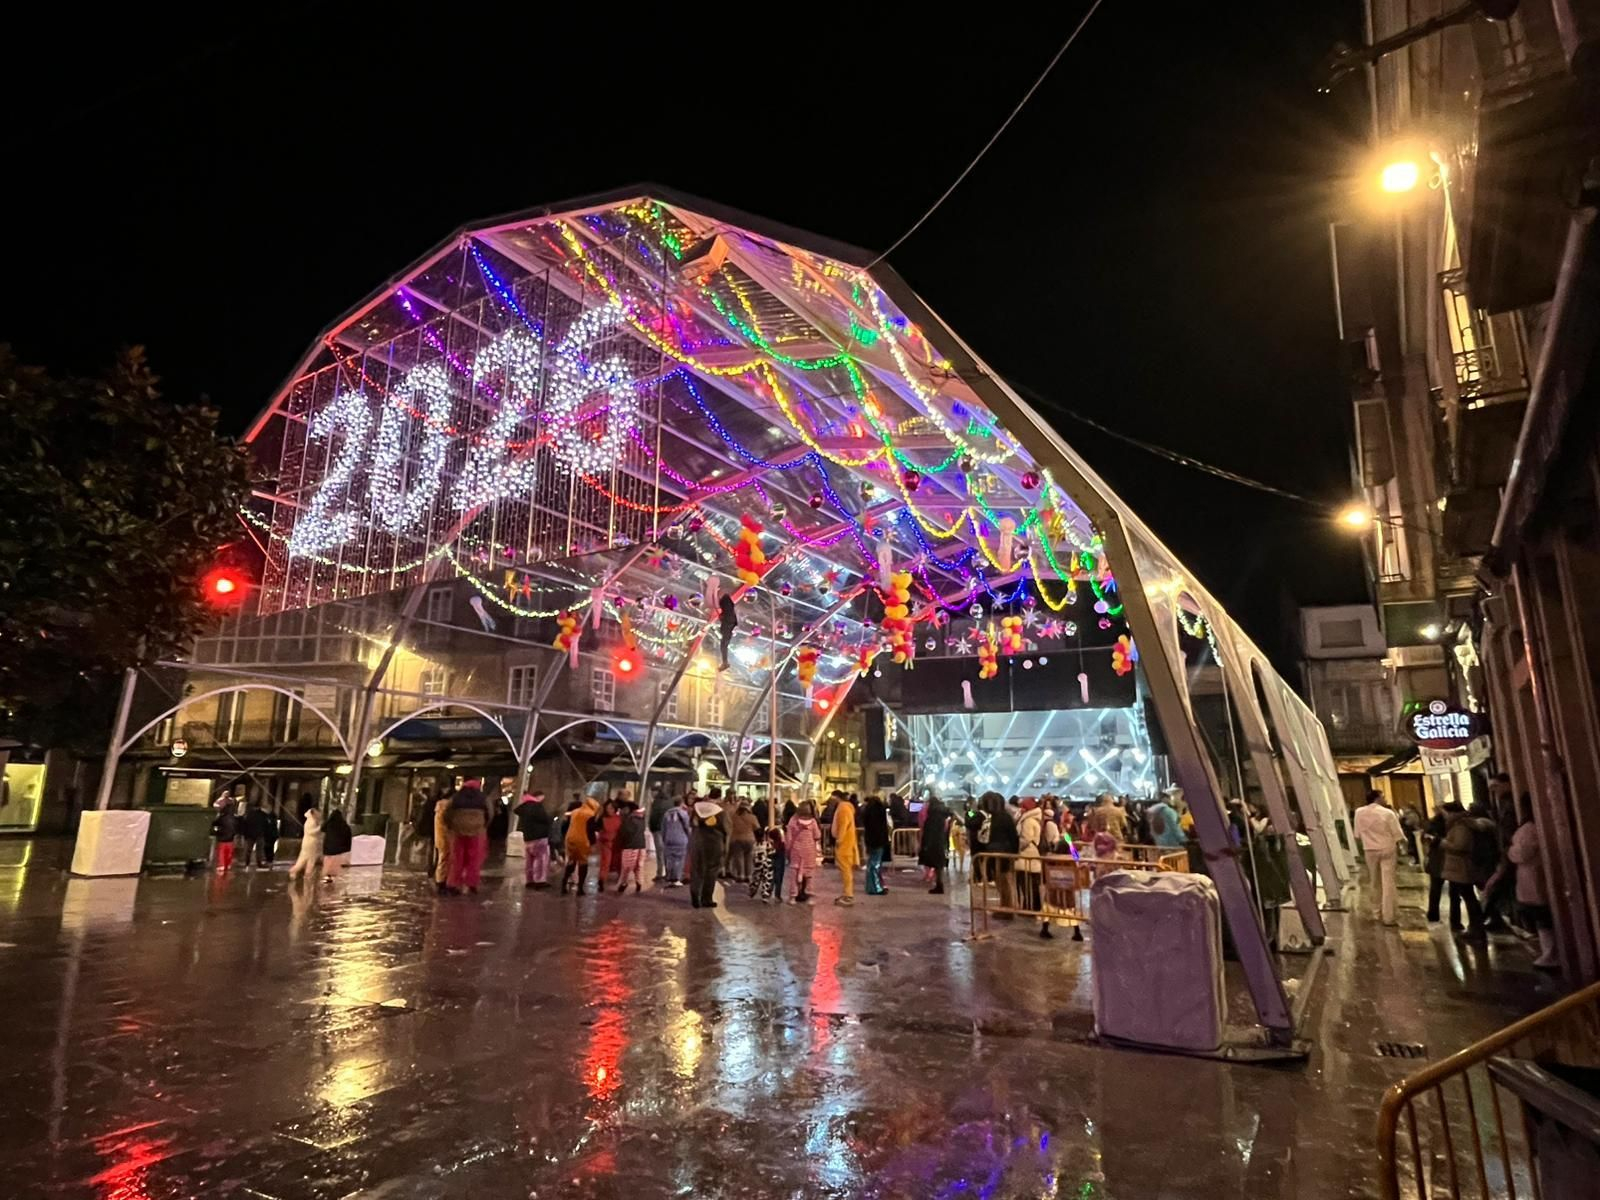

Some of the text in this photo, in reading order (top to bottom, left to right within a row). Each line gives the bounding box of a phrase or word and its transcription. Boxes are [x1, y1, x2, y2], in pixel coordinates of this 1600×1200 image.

[288, 303, 639, 557] 2026
[1413, 712, 1470, 726] Estrella
[1415, 726, 1469, 739] Galicia
